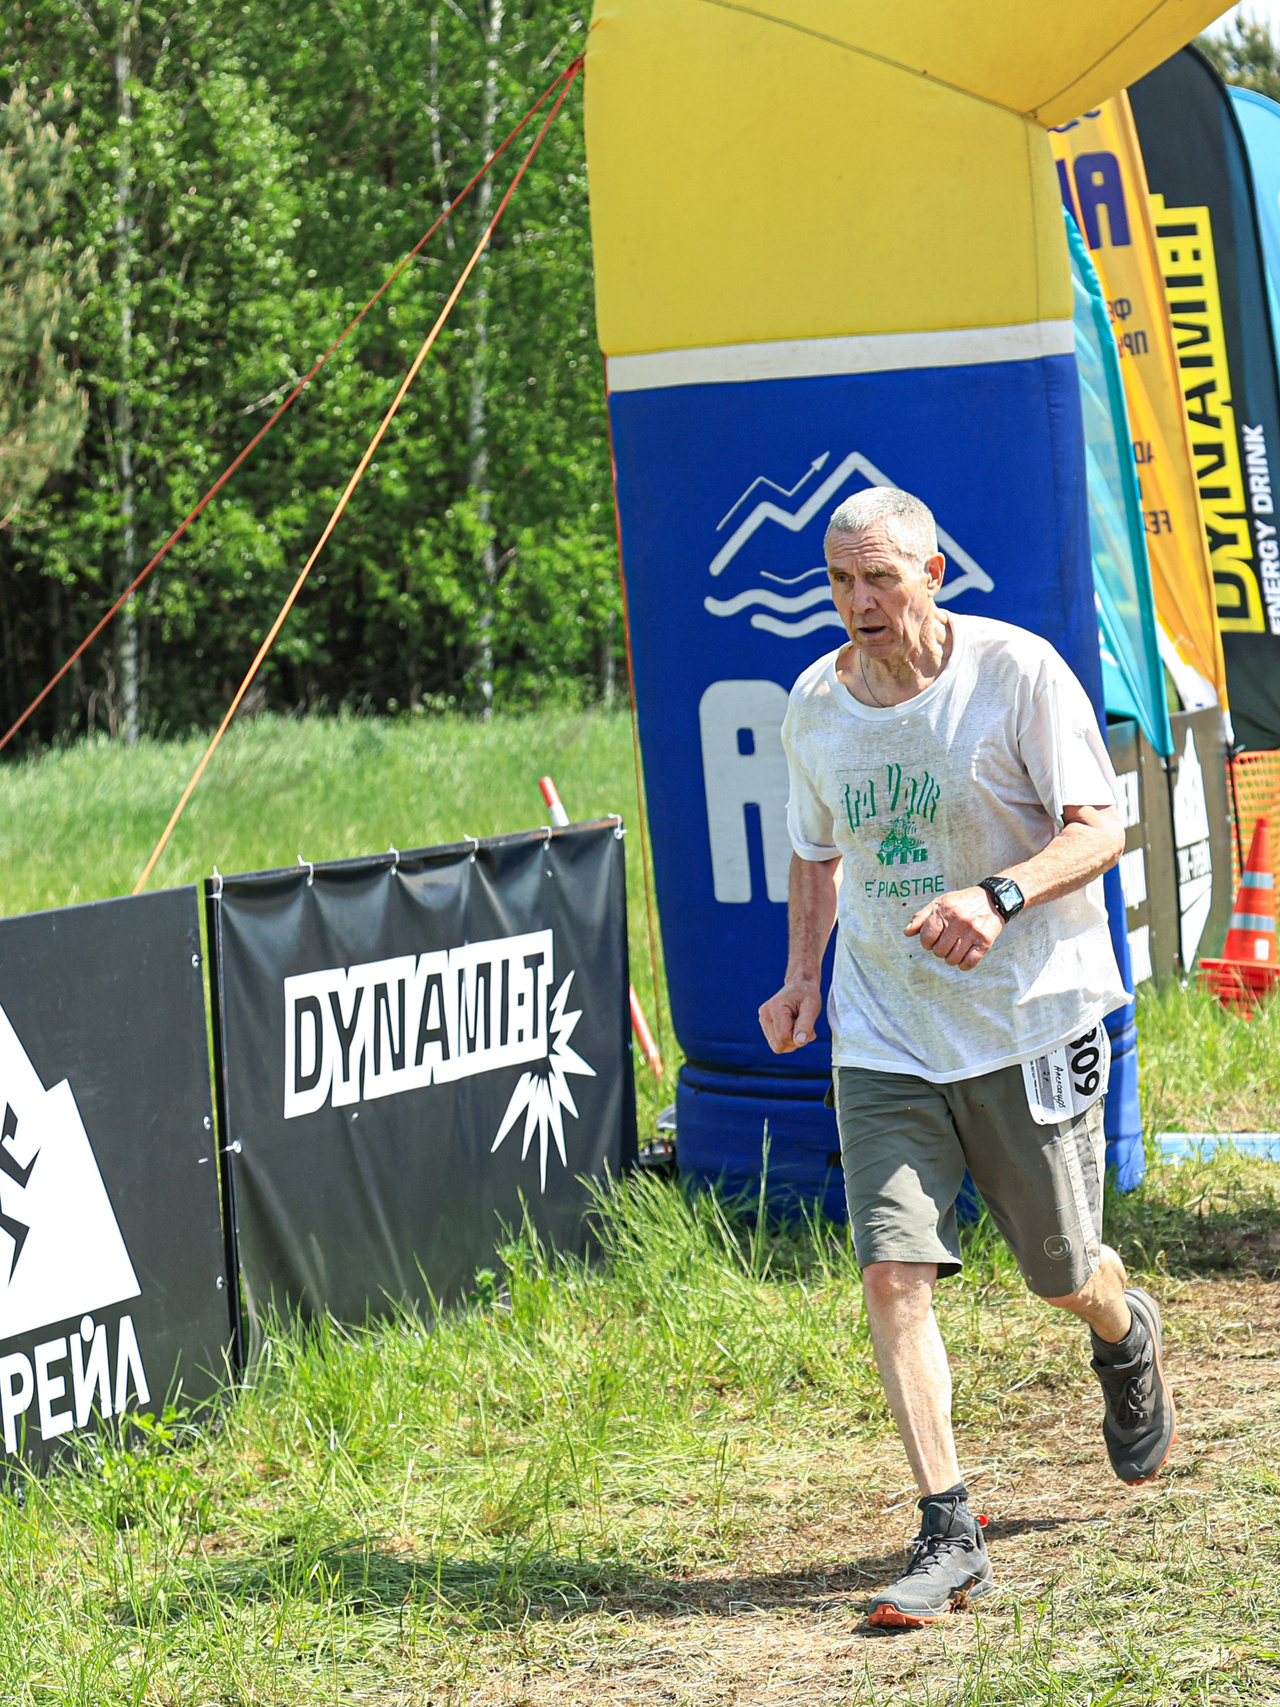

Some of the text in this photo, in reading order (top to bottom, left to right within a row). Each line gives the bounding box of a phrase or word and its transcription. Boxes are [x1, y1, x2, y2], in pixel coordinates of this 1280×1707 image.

[1242, 424, 1274, 514] DRINK
[876, 847, 929, 867] MTB
[877, 874, 946, 899] PIASTRE
